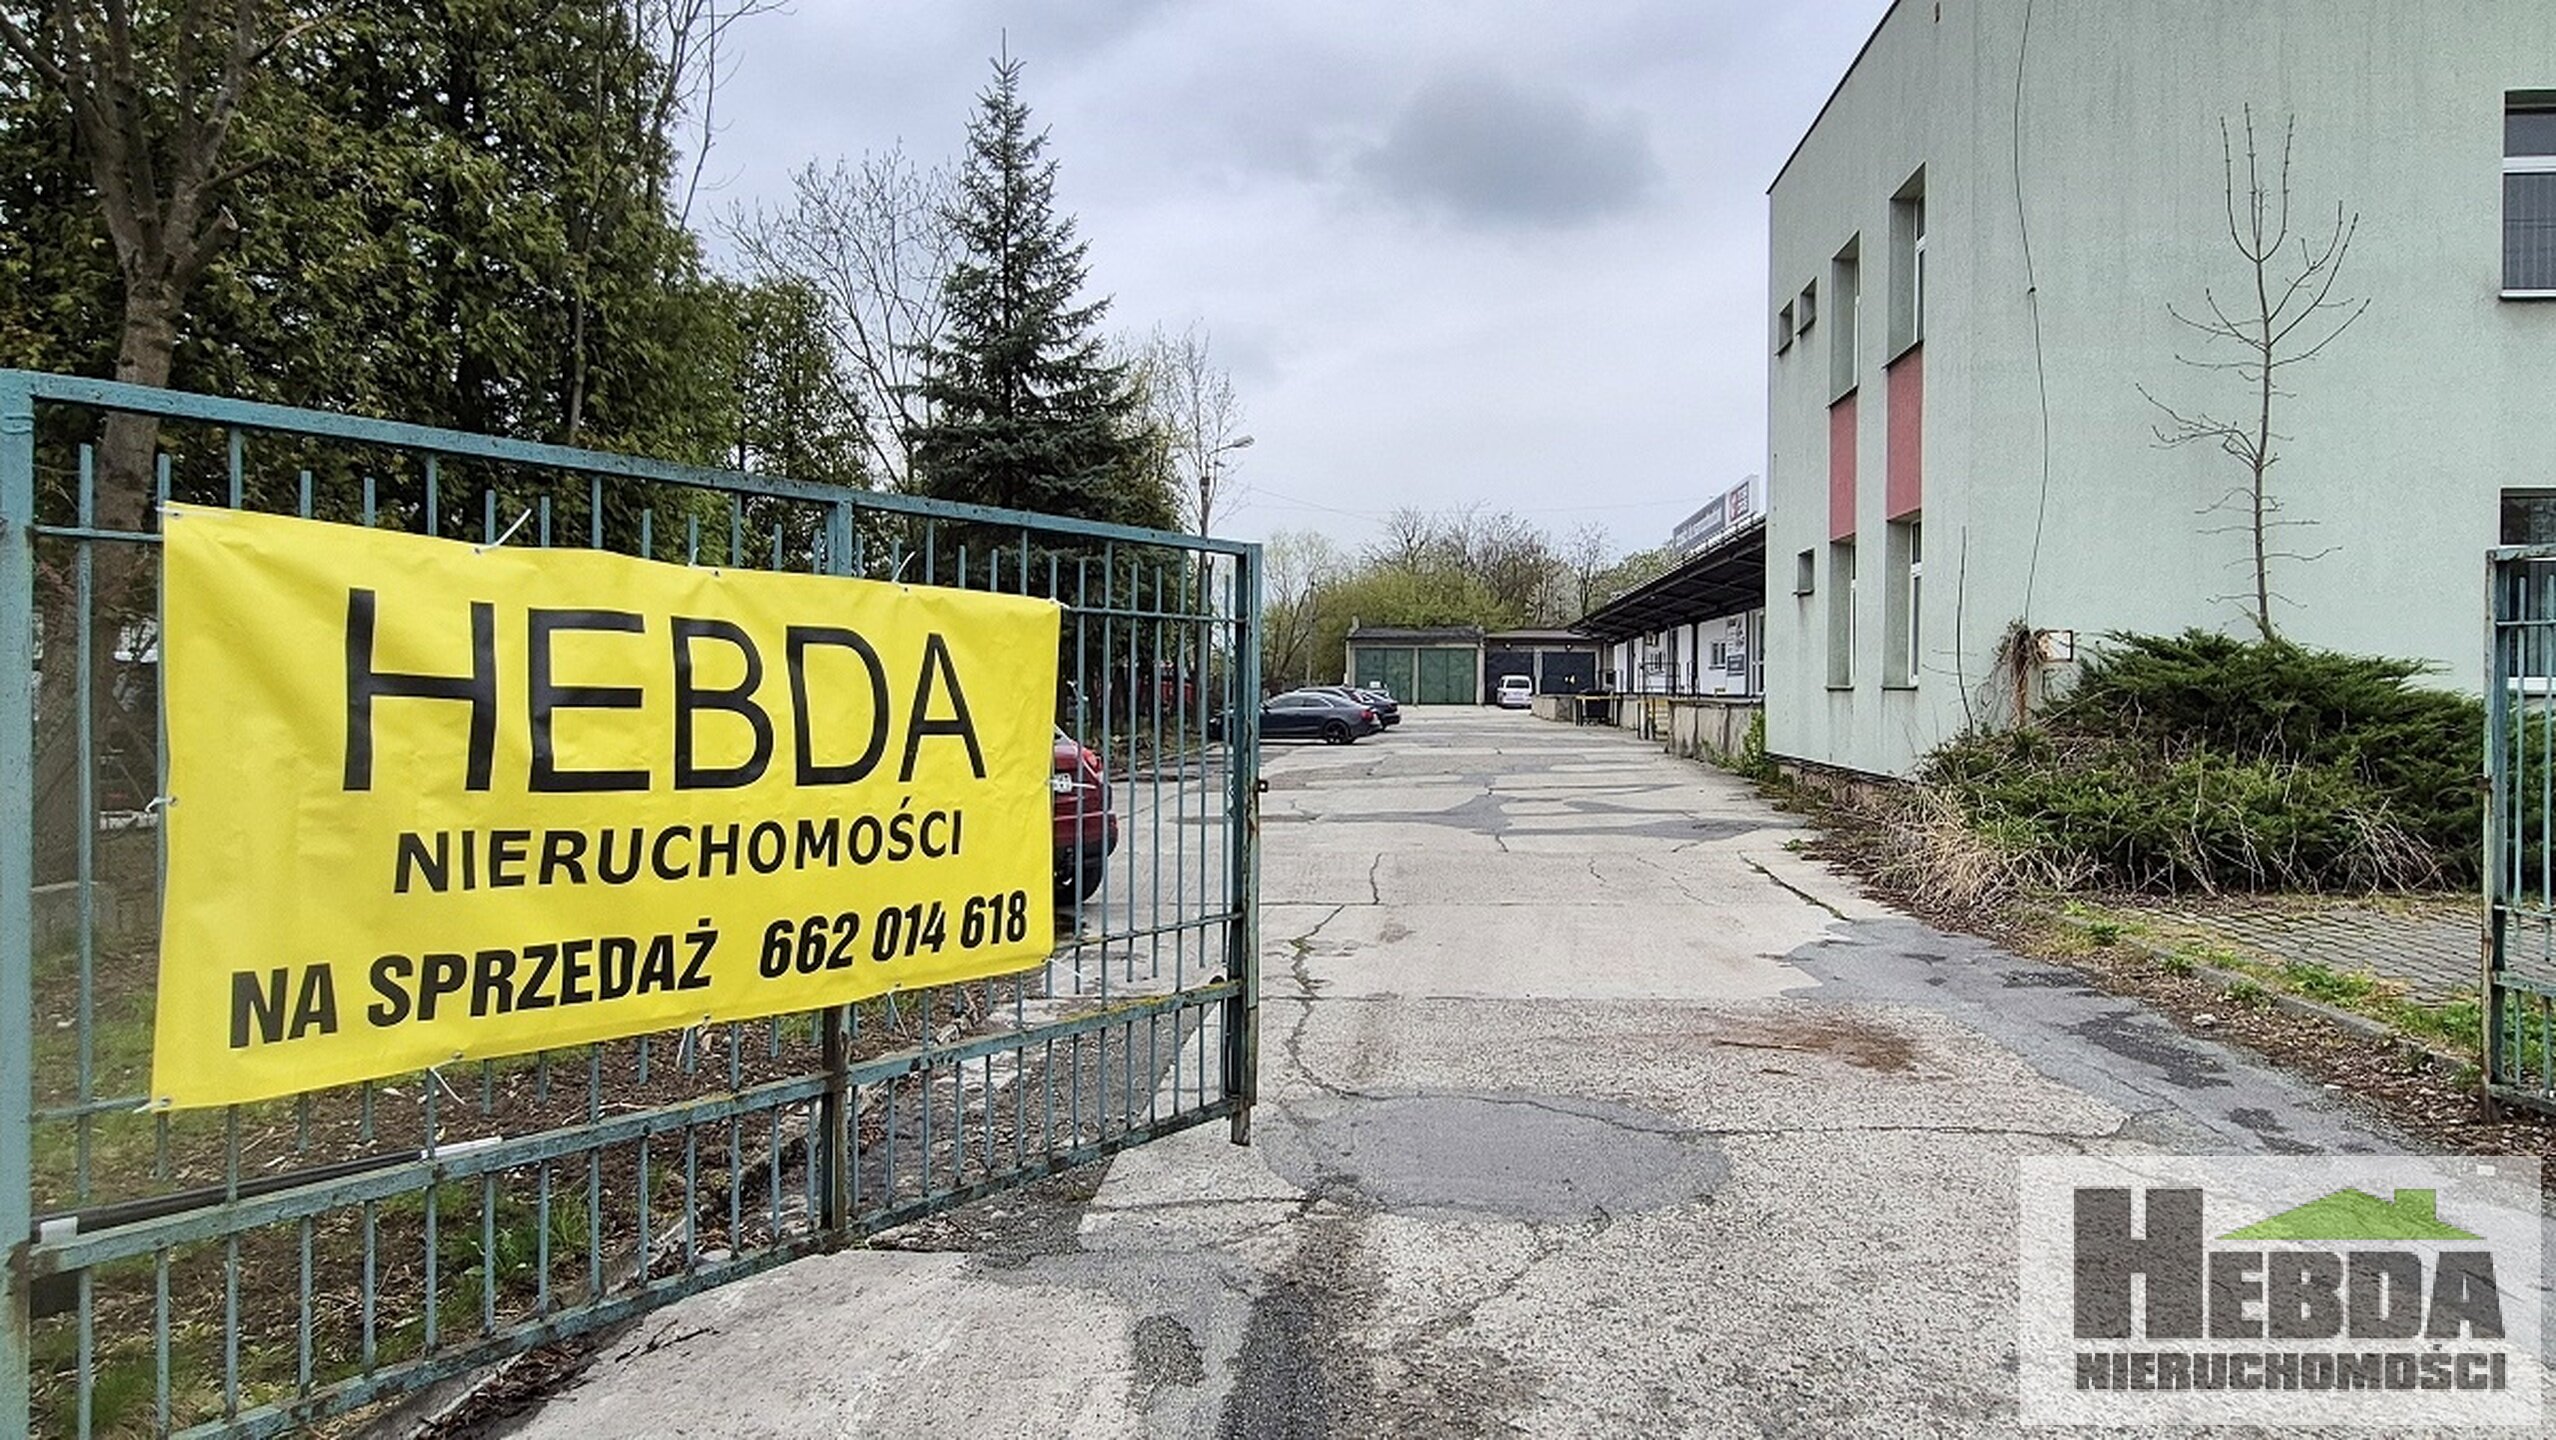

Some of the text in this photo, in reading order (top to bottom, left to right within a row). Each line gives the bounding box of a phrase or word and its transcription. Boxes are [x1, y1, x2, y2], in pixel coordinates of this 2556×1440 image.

[343, 588, 986, 792] HEBDA
[393, 797, 962, 893] NIERUCHOMOŚCI
[229, 890, 1028, 1049] NA SPRZEDAŻ 662 014 618
